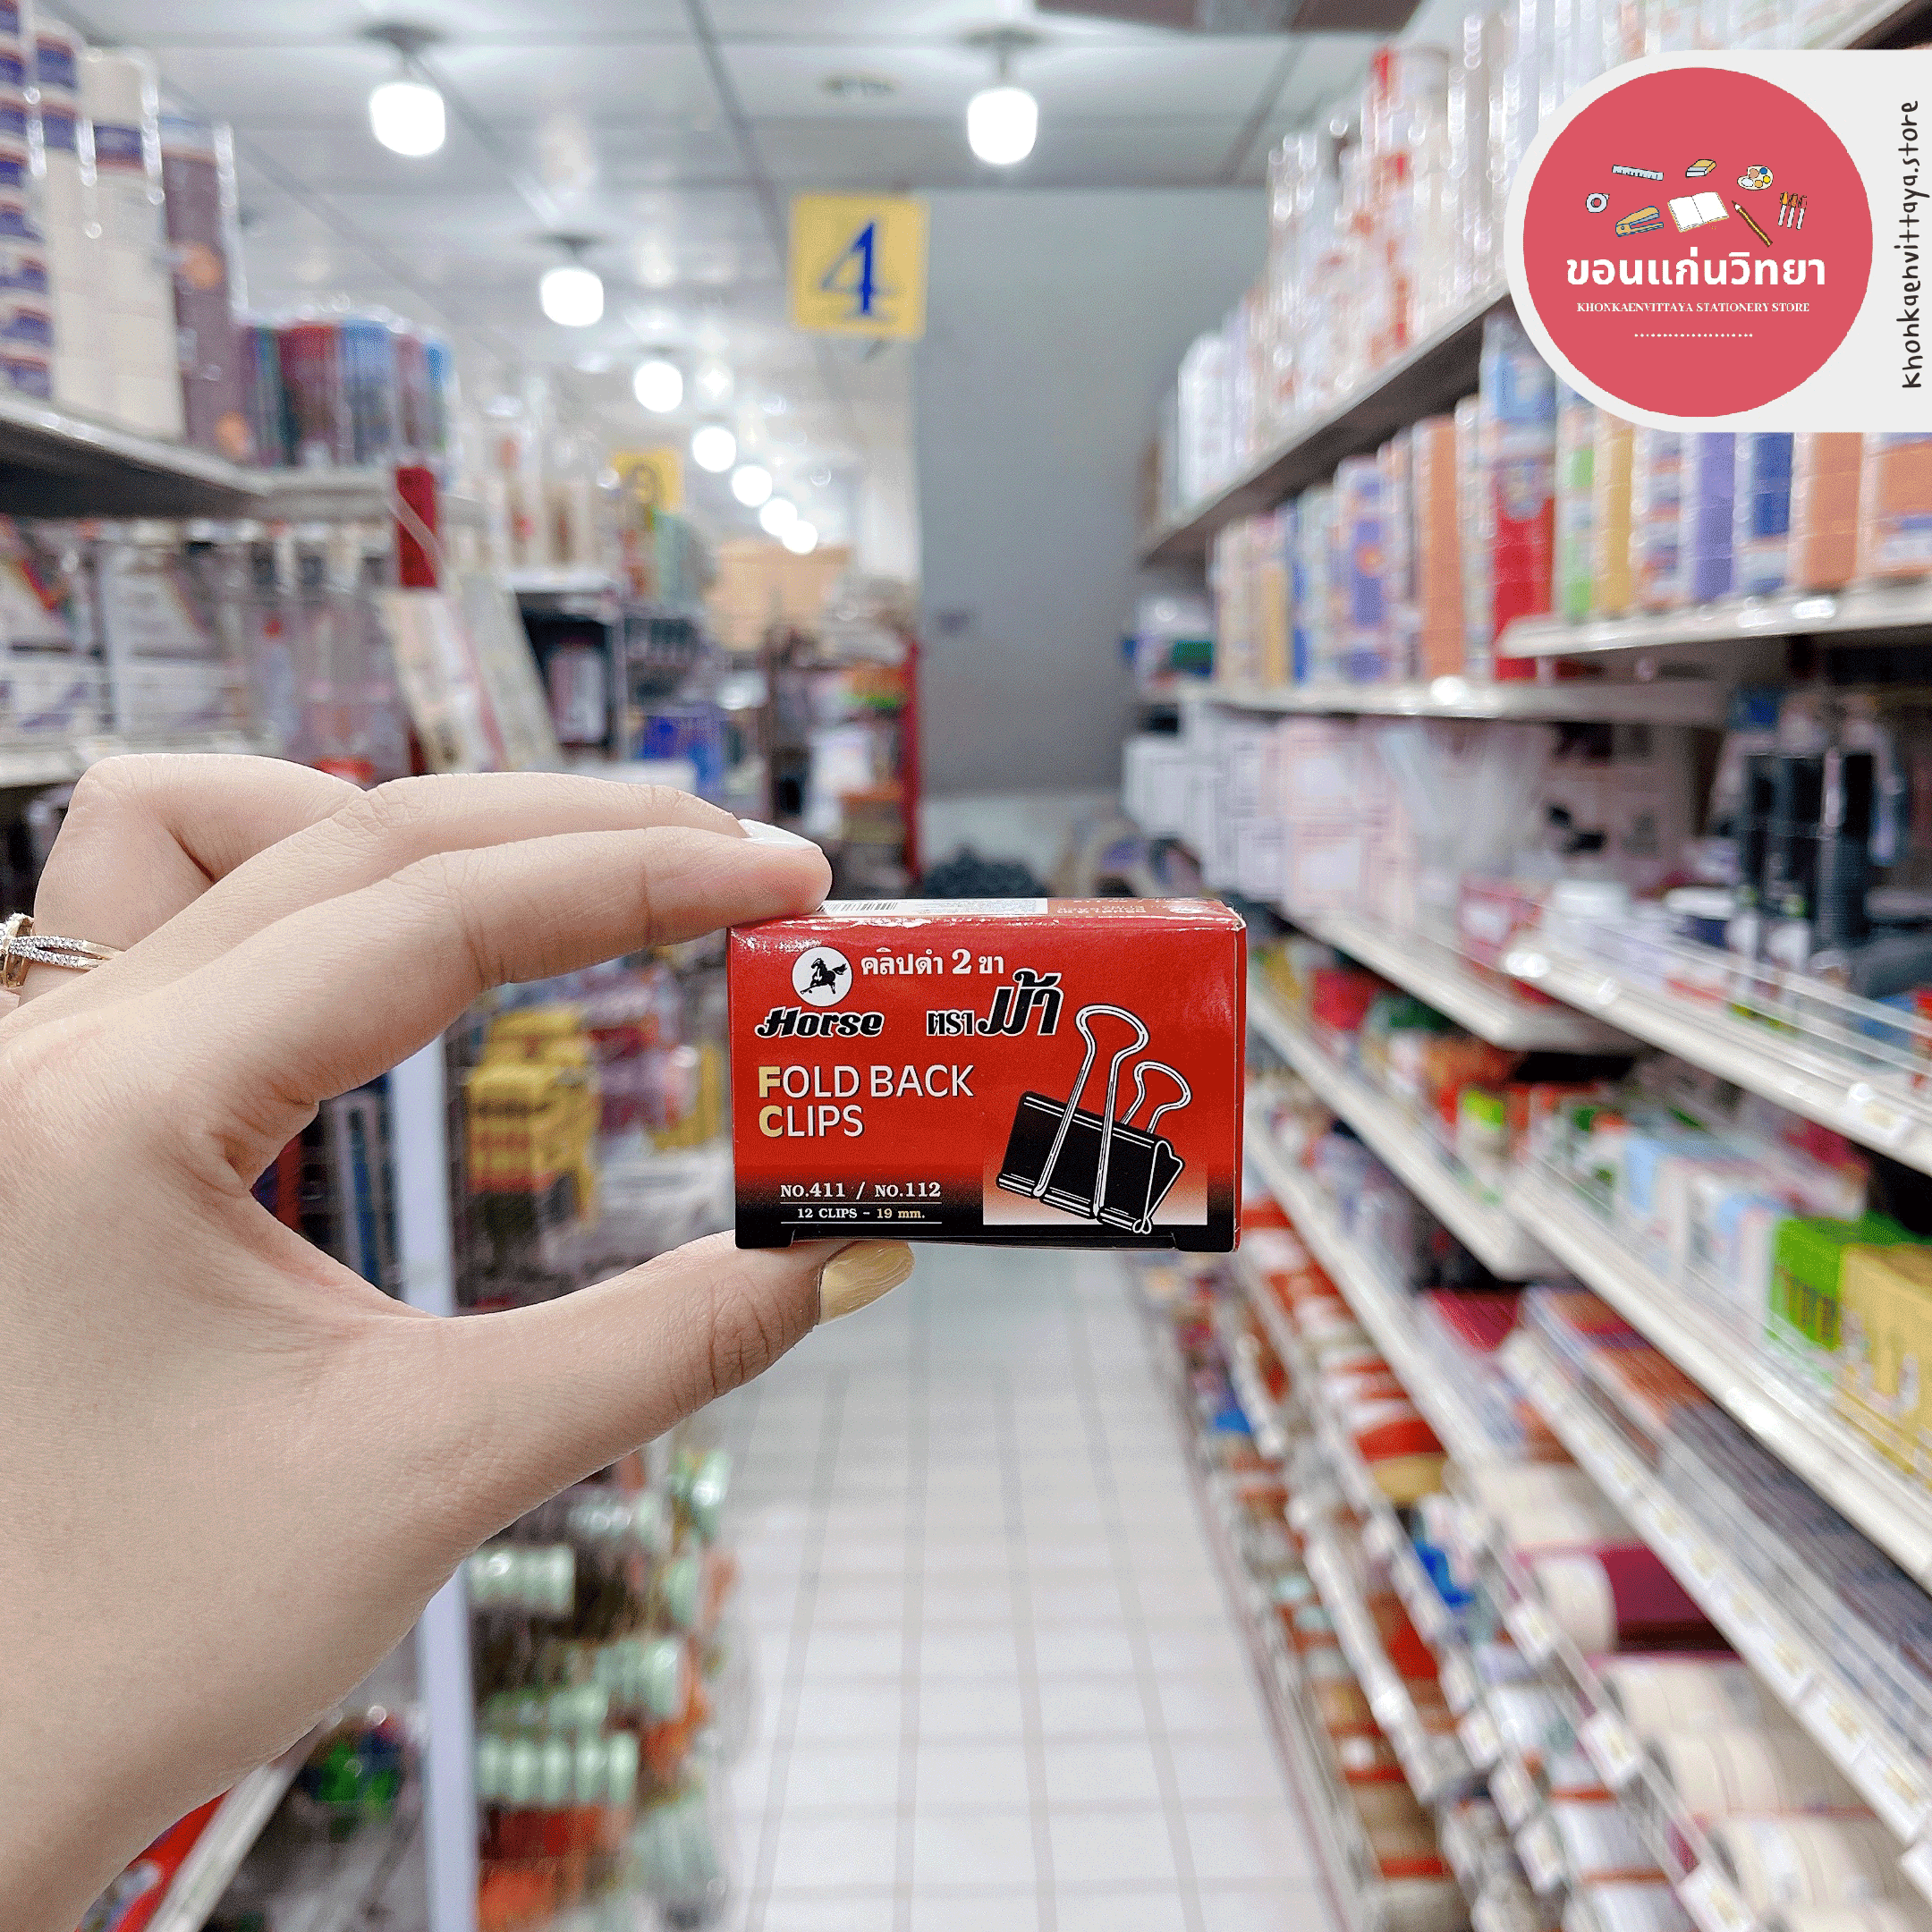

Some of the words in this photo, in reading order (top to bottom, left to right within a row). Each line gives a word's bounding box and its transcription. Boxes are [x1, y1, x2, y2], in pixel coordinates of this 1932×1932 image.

[820, 220, 897, 318] 4
[860, 947, 944, 976] คลิปดำ
[952, 950, 972, 974] 2
[979, 955, 1004, 975] ขา
[754, 1006, 885, 1038] Horse
[758, 1065, 860, 1098] FOLD
[870, 1064, 974, 1097] BACK
[758, 1105, 864, 1138] CLIPS
[780, 1182, 846, 1199] NO.411
[855, 1182, 866, 1199] /
[874, 1182, 942, 1198] NO.112
[797, 1208, 814, 1219] 12
[818, 1208, 858, 1220] CLIPS
[876, 1208, 894, 1219] 19
[897, 1208, 926, 1220] mm.
